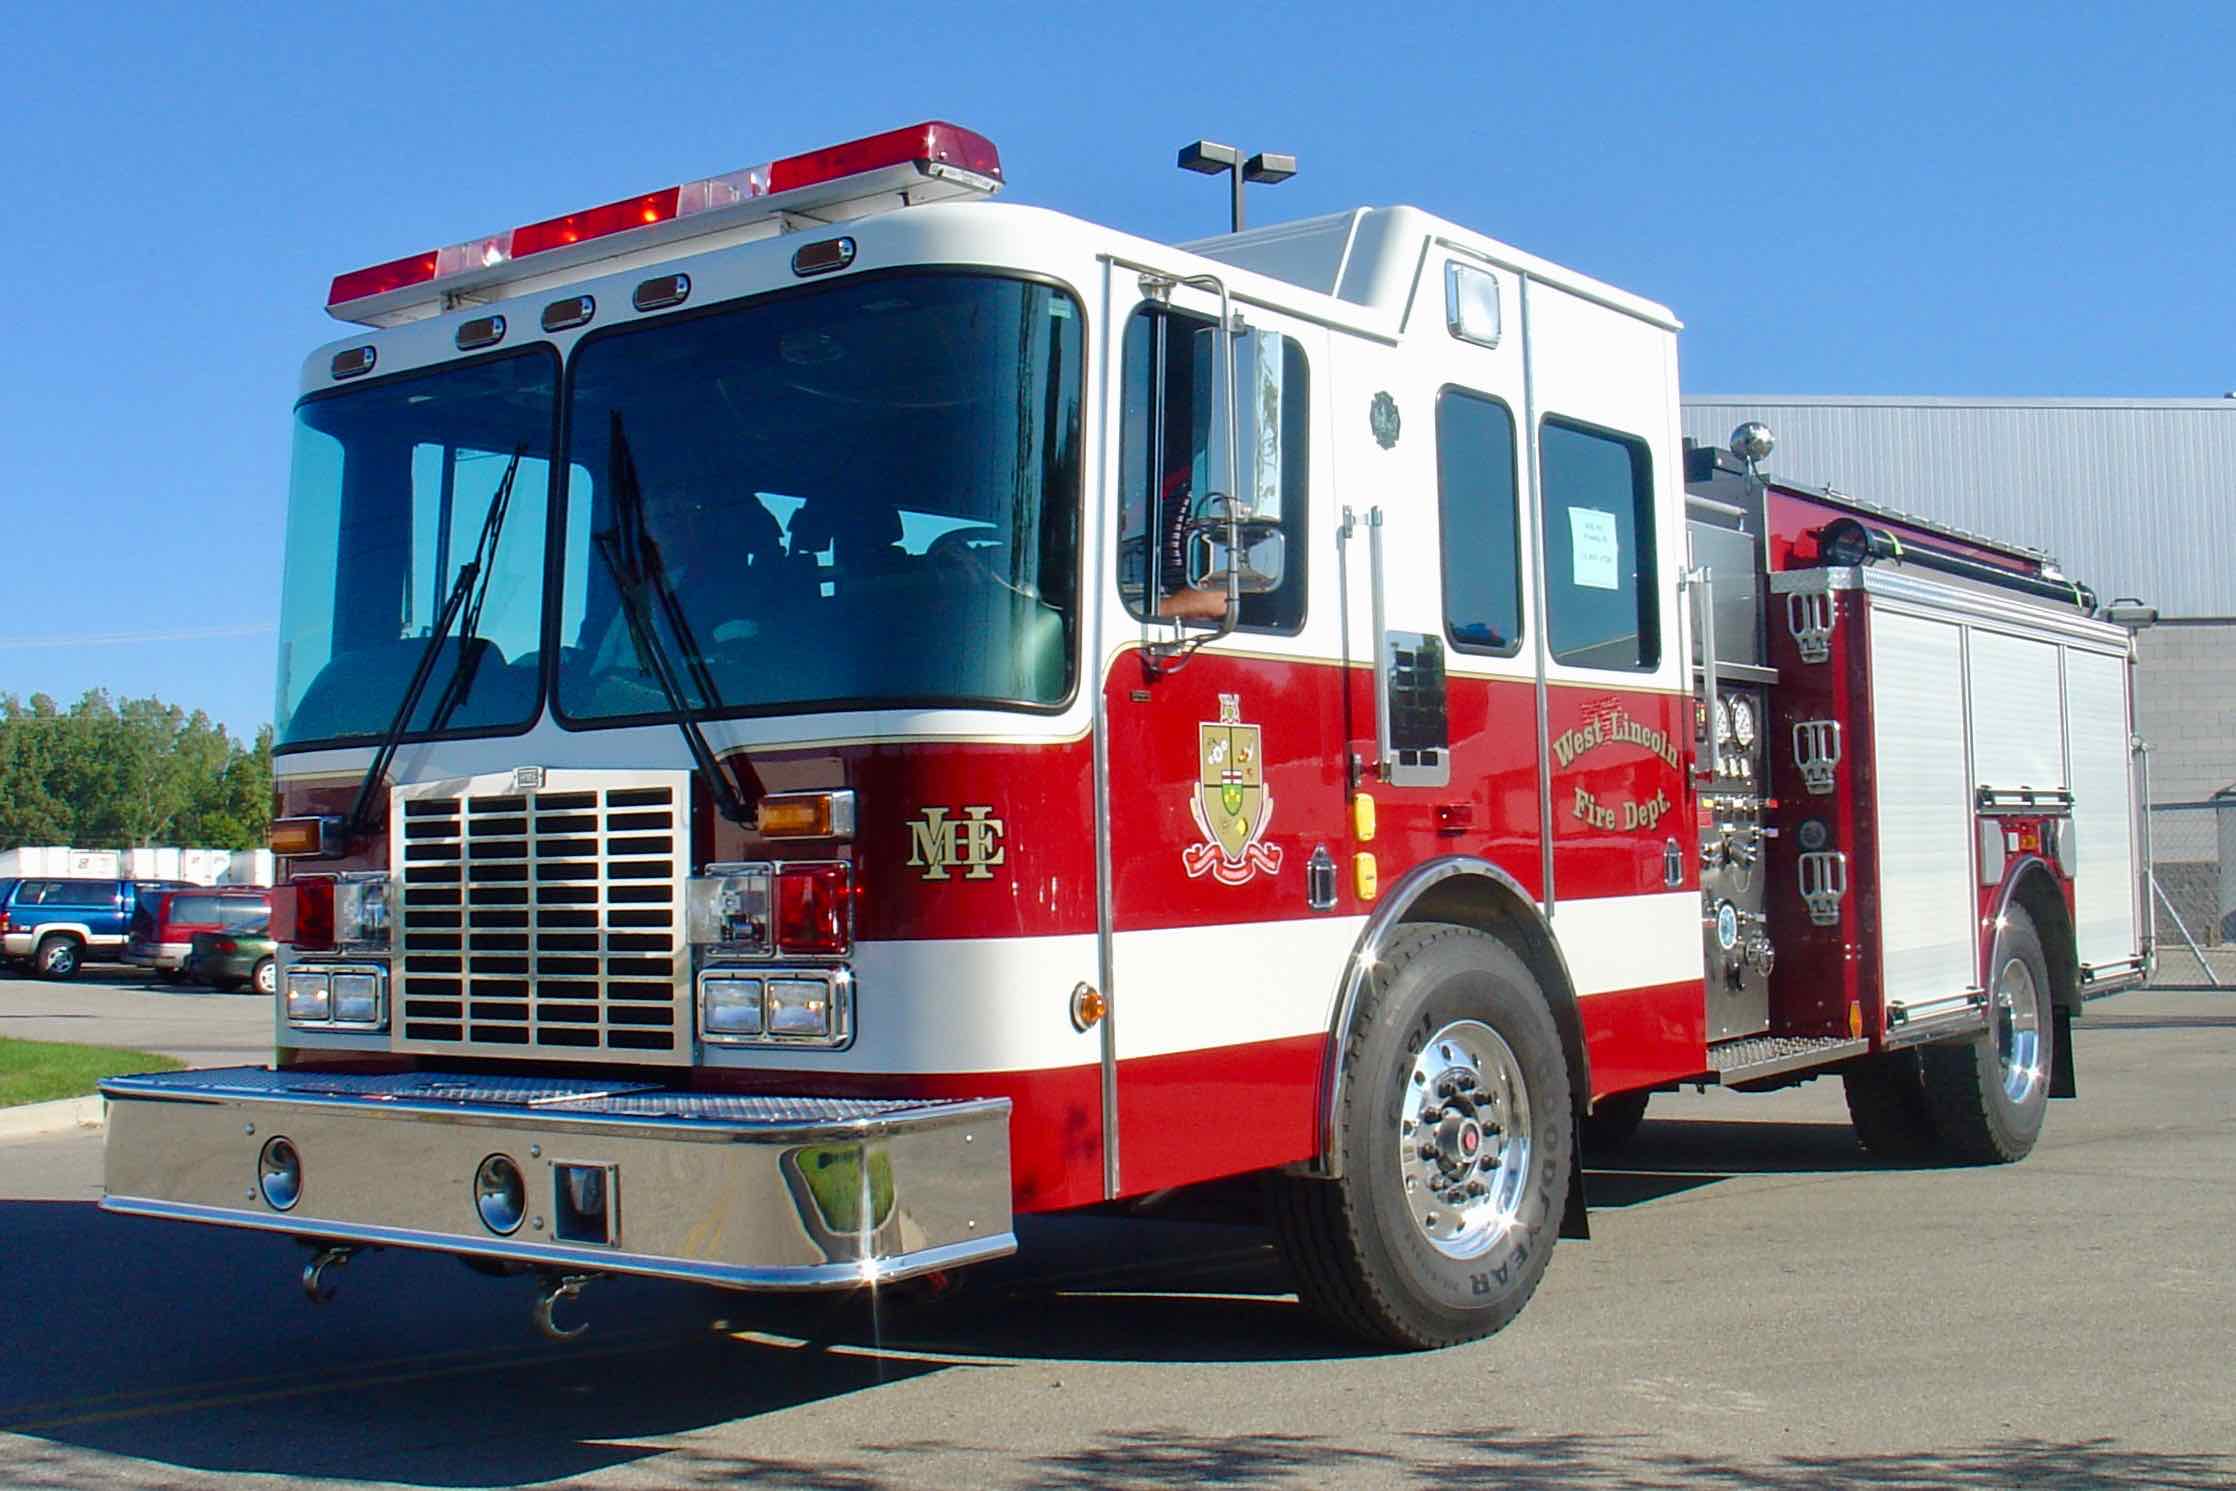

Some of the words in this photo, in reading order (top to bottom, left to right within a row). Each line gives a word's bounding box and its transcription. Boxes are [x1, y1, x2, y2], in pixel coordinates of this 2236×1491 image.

[1552, 713, 1606, 768] West
[1610, 711, 1679, 769] Lincoln
[1572, 786, 1616, 830] Fire
[1622, 787, 1672, 832] Dept.
